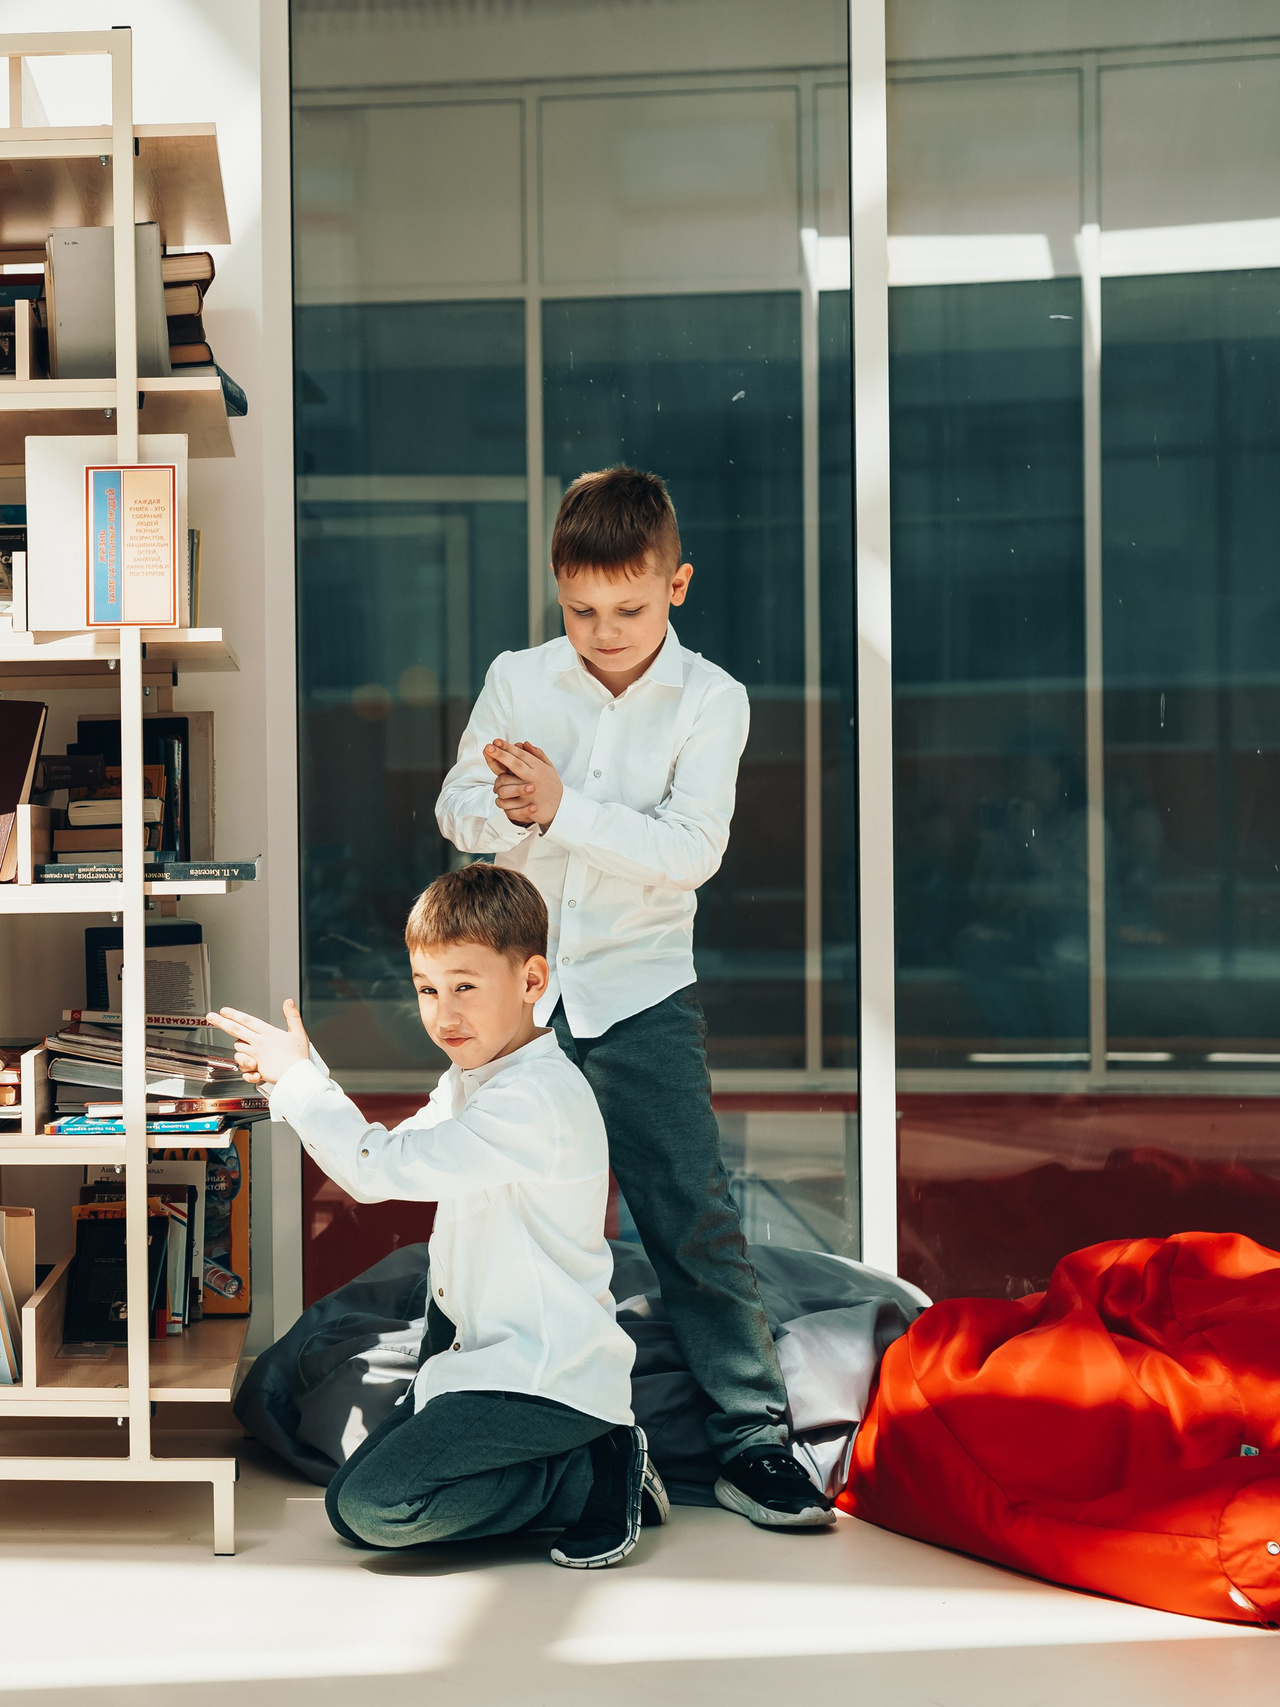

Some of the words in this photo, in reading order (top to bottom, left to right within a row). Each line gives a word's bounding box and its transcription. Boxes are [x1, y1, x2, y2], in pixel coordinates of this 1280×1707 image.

[105, 488, 117, 523] ЛЮДЕЙ
[98, 529, 106, 564] ЖИЗНЬ
[108, 525, 116, 604] ЗАМЕЧАТЕЛЬНЫХ
[189, 869, 220, 877] Киселёв
[230, 868, 239, 876] А.
